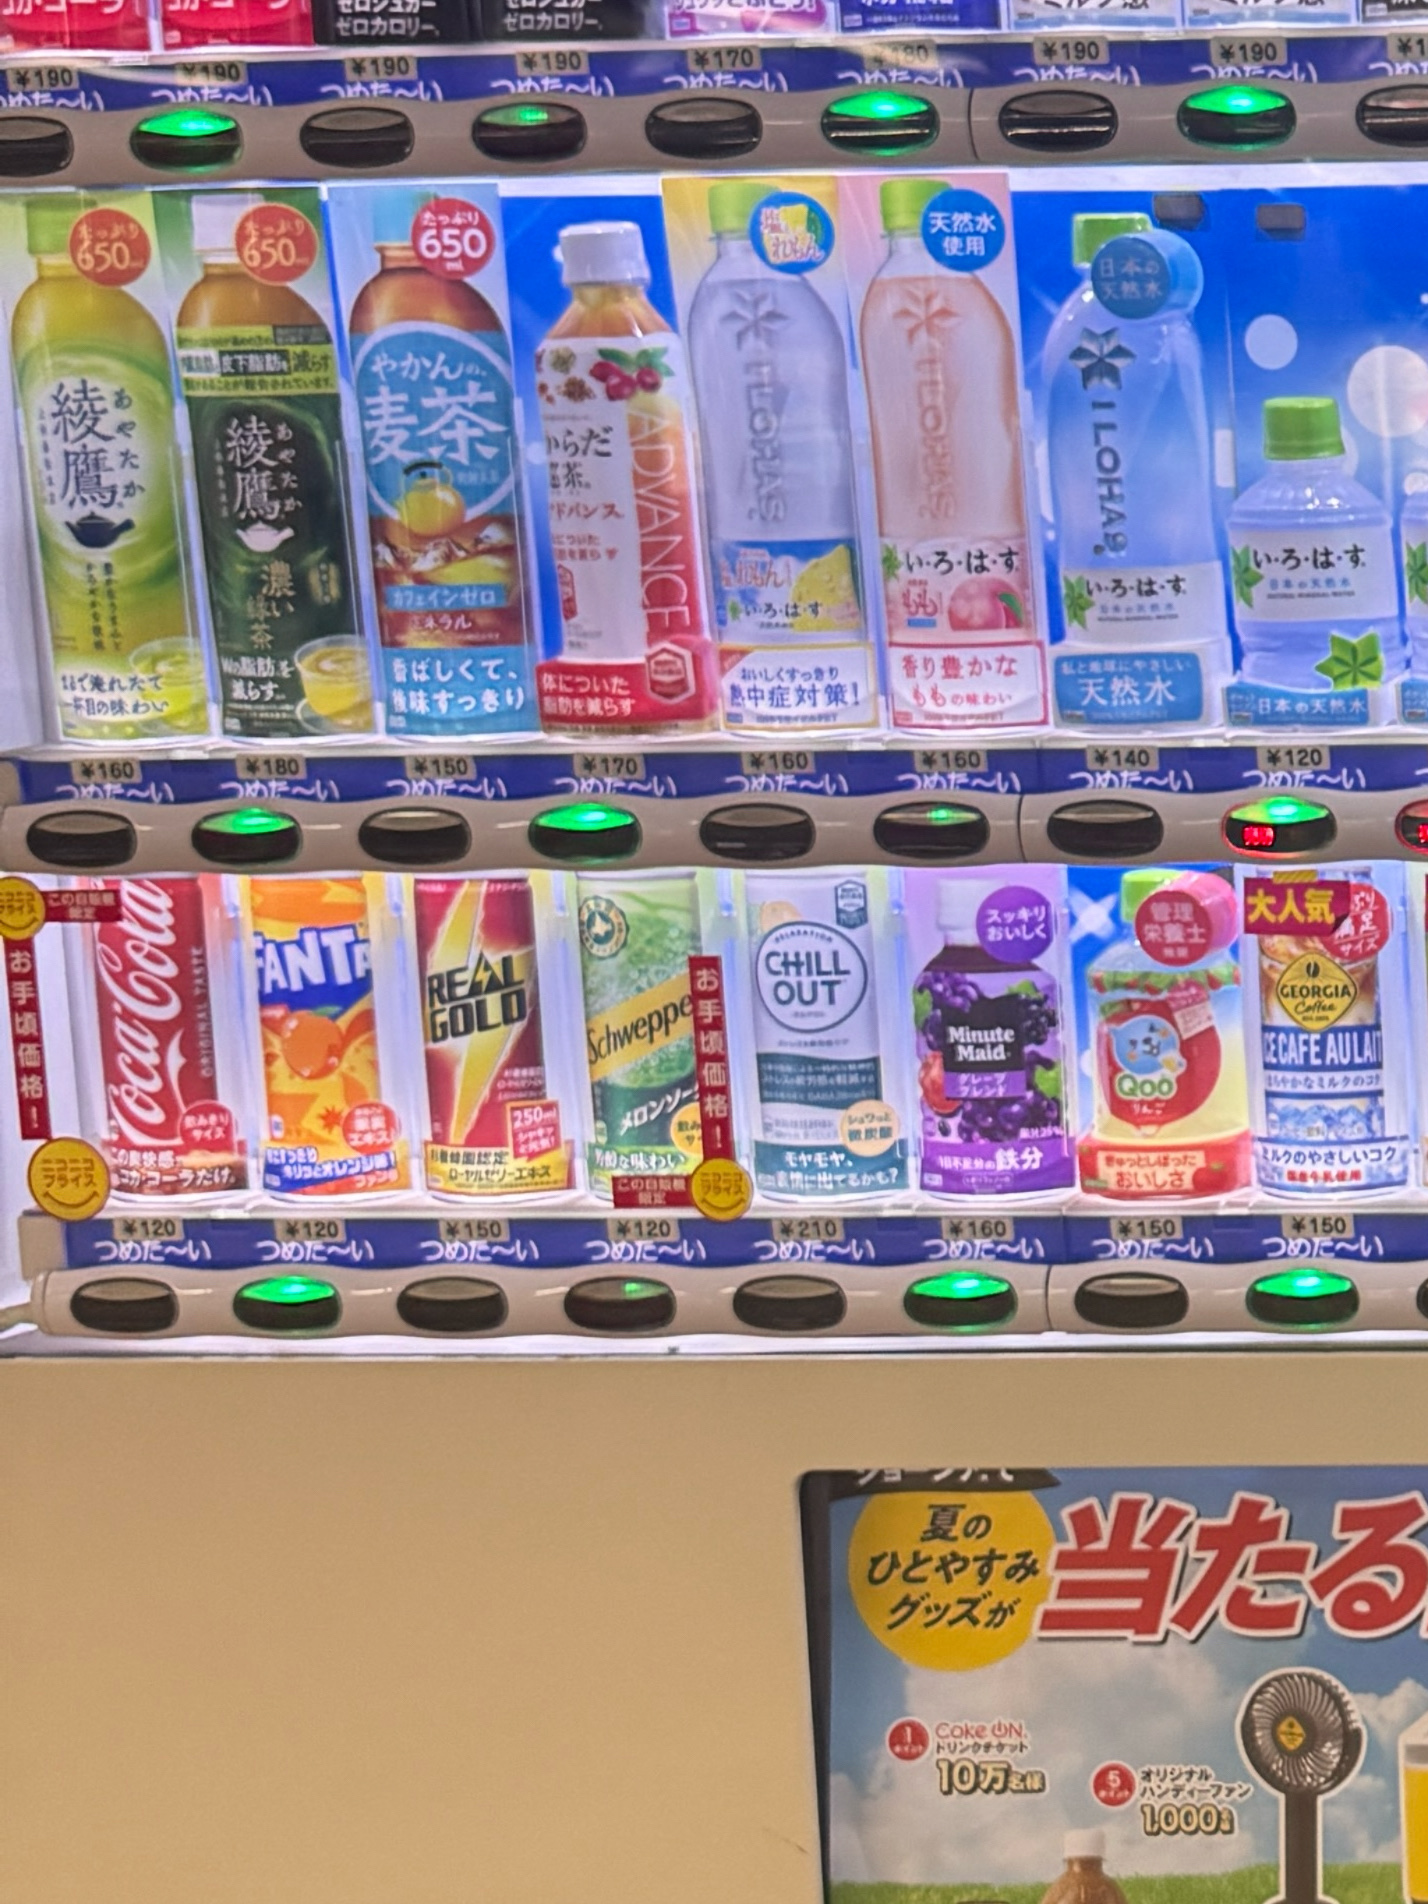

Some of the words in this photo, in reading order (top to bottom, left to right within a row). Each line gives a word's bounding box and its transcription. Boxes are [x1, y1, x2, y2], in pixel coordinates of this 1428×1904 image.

[1041, 41, 1100, 61] ¥190
[522, 51, 582, 72] ¥190
[14, 68, 74, 89] ¥190
[929, 211, 997, 233] 天然水
[419, 230, 487, 259] 650
[942, 236, 986, 256] 使用
[362, 384, 510, 467] 麦茶
[50, 377, 118, 510] 綾鷹
[226, 414, 282, 520] 綾鷹
[902, 654, 1019, 679] 香り豊かな
[911, 685, 1012, 706] ももの味わい
[1079, 677, 1176, 707] 天然水
[1258, 697, 1368, 715] 日本の天然水
[245, 758, 300, 776] ¥180
[581, 757, 639, 777] ¥170
[921, 750, 982, 770] ¥160
[1266, 749, 1322, 766] ¥120
[986, 908, 1046, 923] スッキリ
[987, 924, 1047, 941] おいしく
[764, 951, 851, 977] CHILL
[427, 952, 526, 1009] REAL
[772, 979, 844, 1006] OUT
[1279, 983, 1352, 999] GEORGIA
[429, 992, 528, 1044] GOLD
[947, 1026, 1015, 1044] Minute
[956, 1043, 1006, 1062] Maid
[1116, 1075, 1173, 1098] Qoo
[1116, 1169, 1187, 1188] おいしさ
[285, 1221, 339, 1237] ¥120
[616, 1221, 671, 1238] ¥120
[949, 1221, 1007, 1237] ¥160
[1292, 1215, 1347, 1234] ¥150
[920, 1503, 992, 1542] 夏の
[867, 1548, 1040, 1586] ひとやすみ
[886, 1591, 1020, 1631] グッズが
[935, 1741, 1029, 1755] ドリンクチケット
[1139, 1767, 1214, 1784] オリジナル
